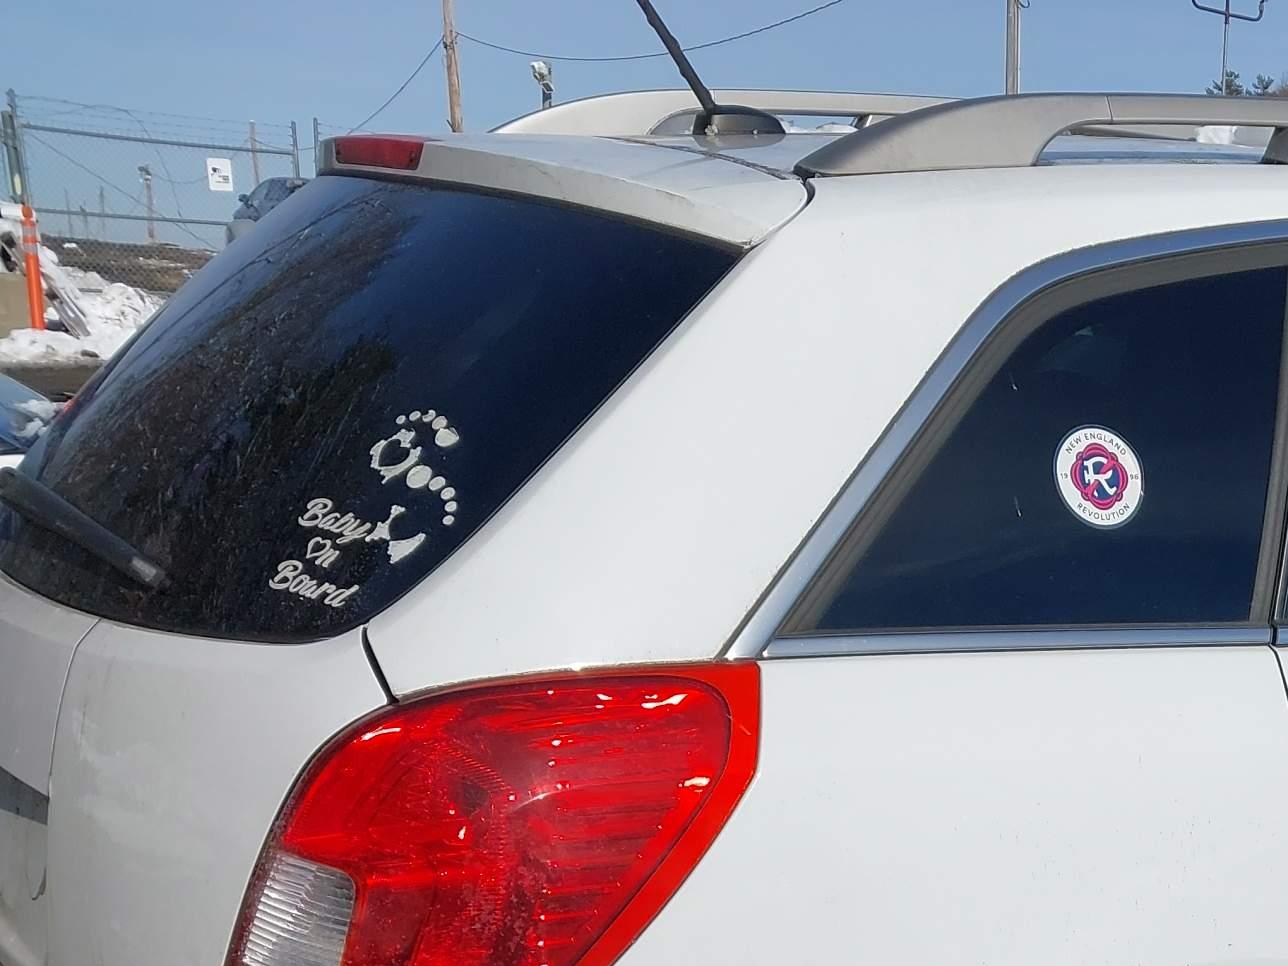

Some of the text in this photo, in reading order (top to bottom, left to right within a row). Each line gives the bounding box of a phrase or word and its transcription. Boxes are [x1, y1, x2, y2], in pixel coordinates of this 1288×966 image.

[1065, 432, 1127, 456] NEW ENGLAND
[1059, 472, 1069, 480] 19
[297, 497, 372, 545] Baby
[1076, 502, 1131, 522] REVOLUTION
[268, 559, 360, 608] Board
